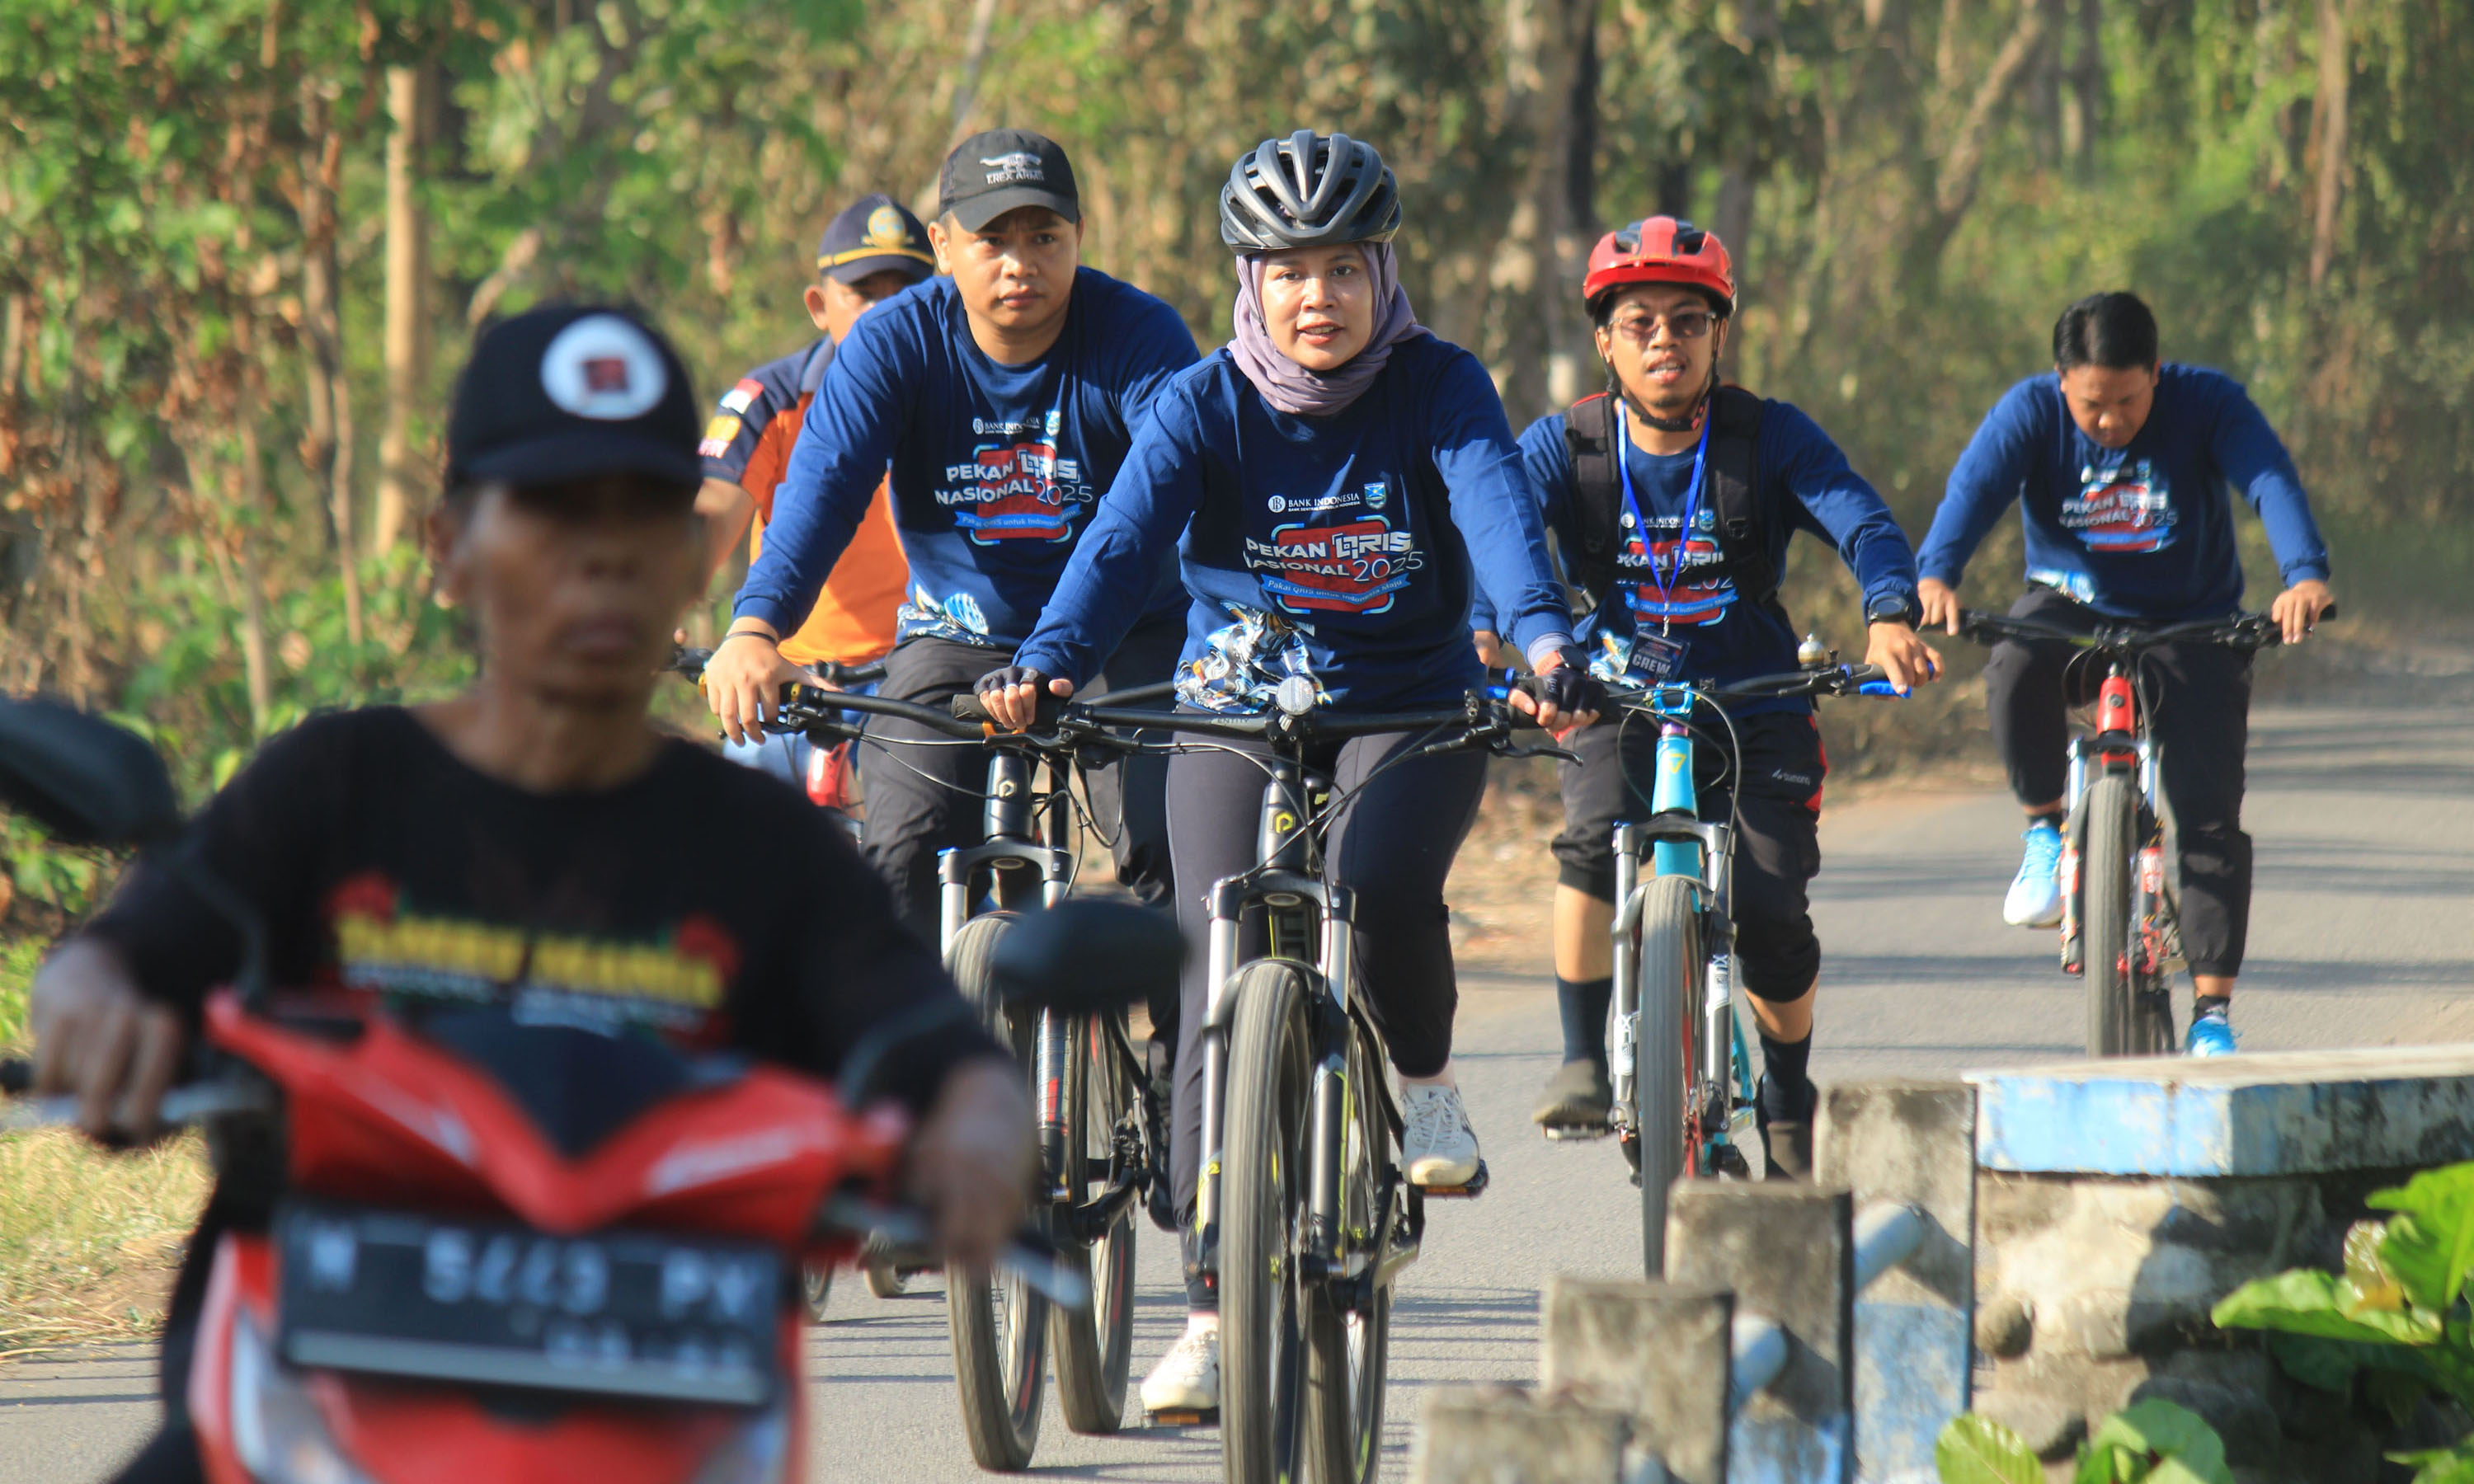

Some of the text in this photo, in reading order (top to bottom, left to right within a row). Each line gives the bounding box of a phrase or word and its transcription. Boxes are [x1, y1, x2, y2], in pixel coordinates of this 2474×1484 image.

[946, 450, 1079, 482] PEKAN QRIS
[934, 478, 1094, 506] NASIONAL 2025
[1288, 493, 1360, 508] BANK INDONESIA
[2062, 495, 2115, 514] PEKAN
[1245, 531, 1413, 559] PEKAN QRIS
[1352, 551, 1424, 582] 2025
[1268, 580, 1291, 591] Pakai
[1381, 580, 1402, 591] Maju
[1632, 654, 1672, 674] CREW
